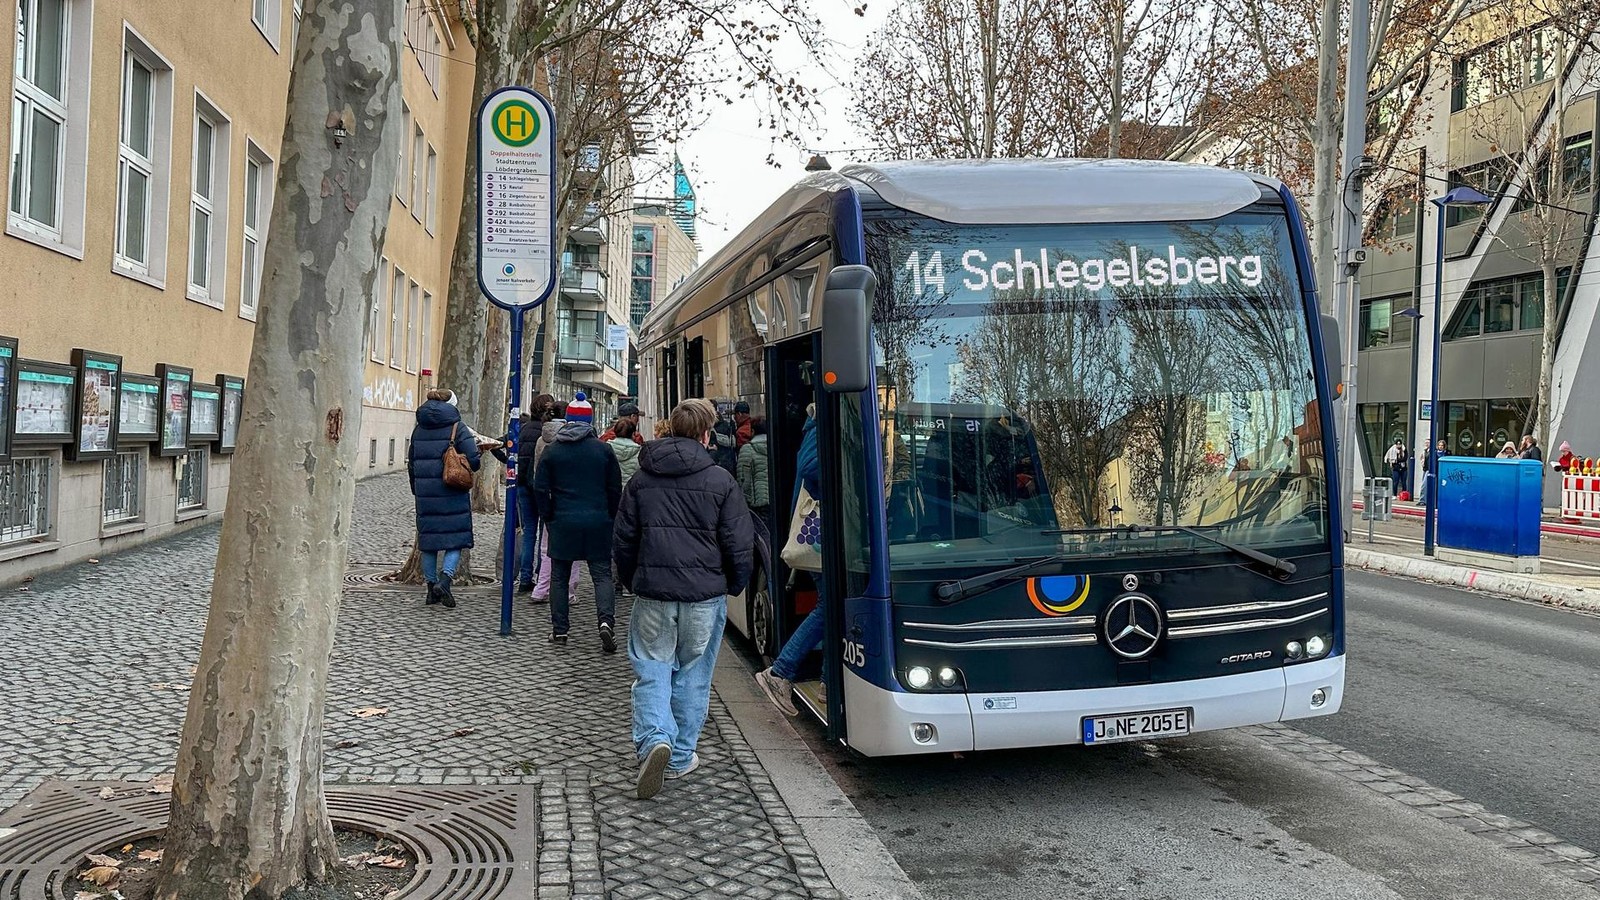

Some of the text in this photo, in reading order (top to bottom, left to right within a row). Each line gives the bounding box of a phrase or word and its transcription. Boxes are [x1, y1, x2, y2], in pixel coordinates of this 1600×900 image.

[506, 110, 526, 136] H
[490, 150, 542, 158] Doppelhaltestelle
[495, 166, 537, 174] Löbdergraben
[905, 245, 1263, 295] 14 Schlegelsberg
[842, 637, 865, 668] 205
[1221, 650, 1272, 664] eCITARO
[1095, 713, 1186, 738] J NE 205 E
